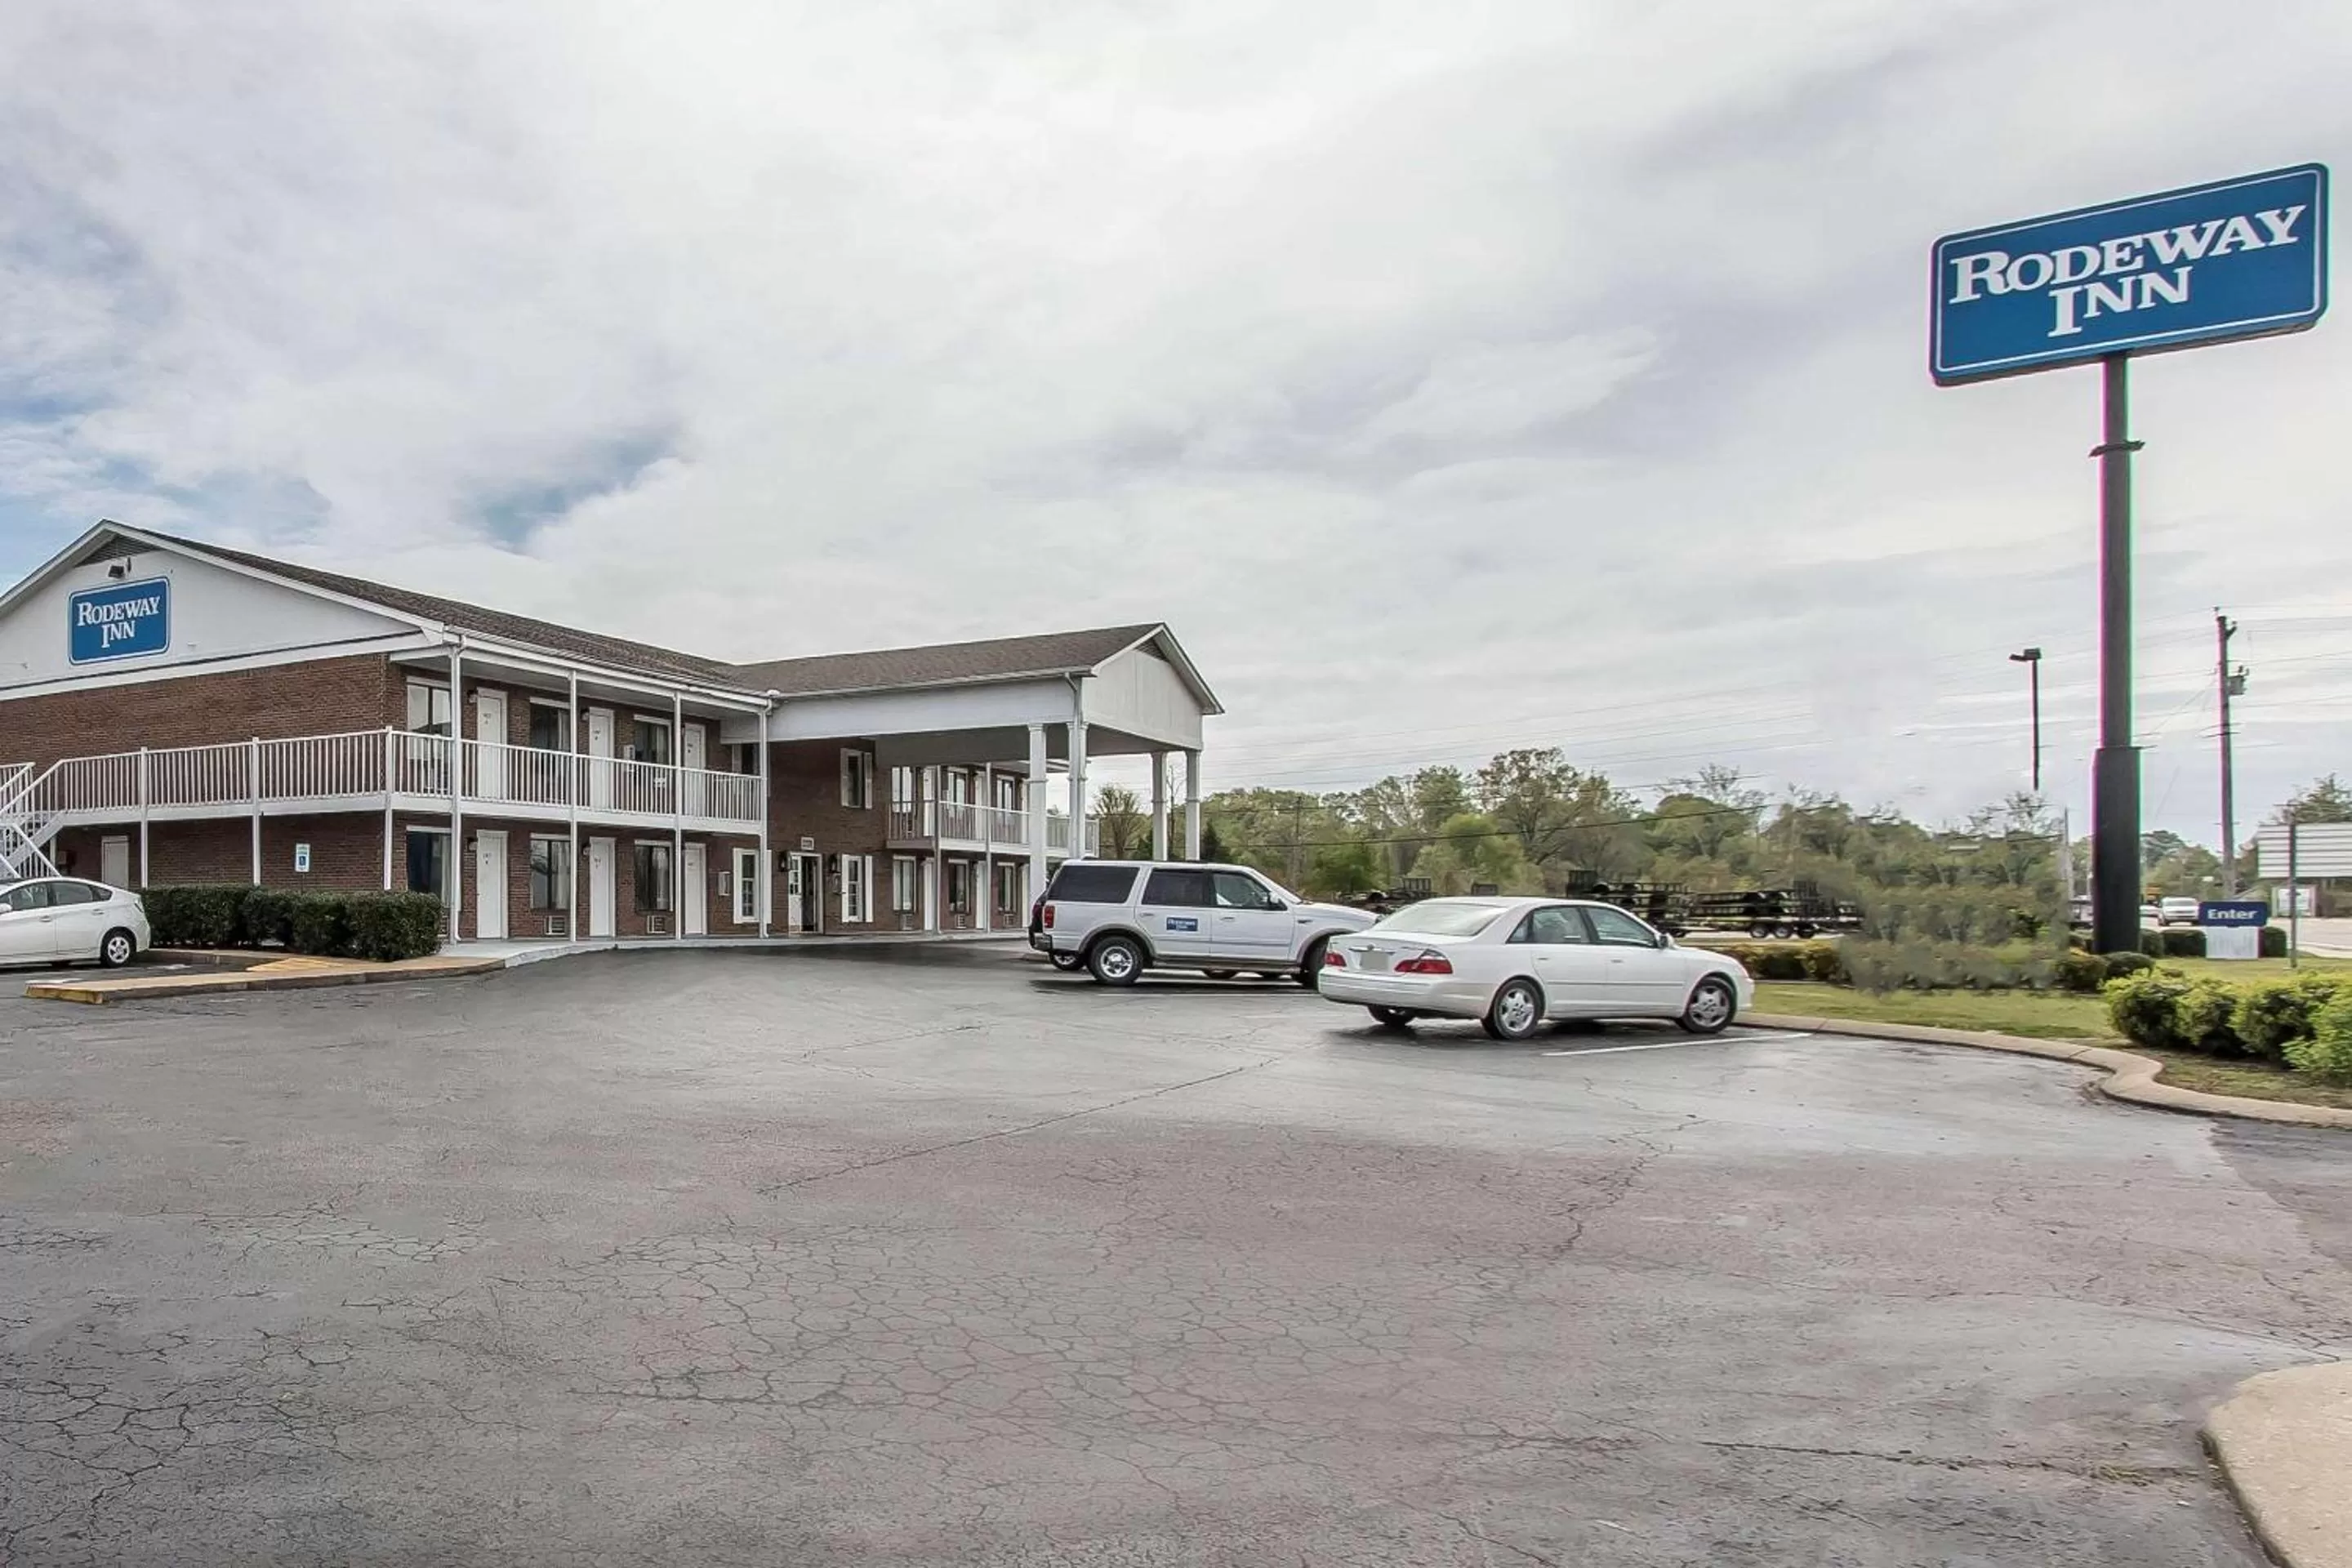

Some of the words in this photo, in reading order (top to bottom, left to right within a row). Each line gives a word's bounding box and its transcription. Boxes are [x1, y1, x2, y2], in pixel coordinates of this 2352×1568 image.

[1949, 205, 2306, 305] RODEWAY
[2047, 265, 2194, 338] INN
[77, 595, 161, 626] RODEWAY
[101, 620, 136, 648] INN
[2207, 908, 2259, 920] Enter
